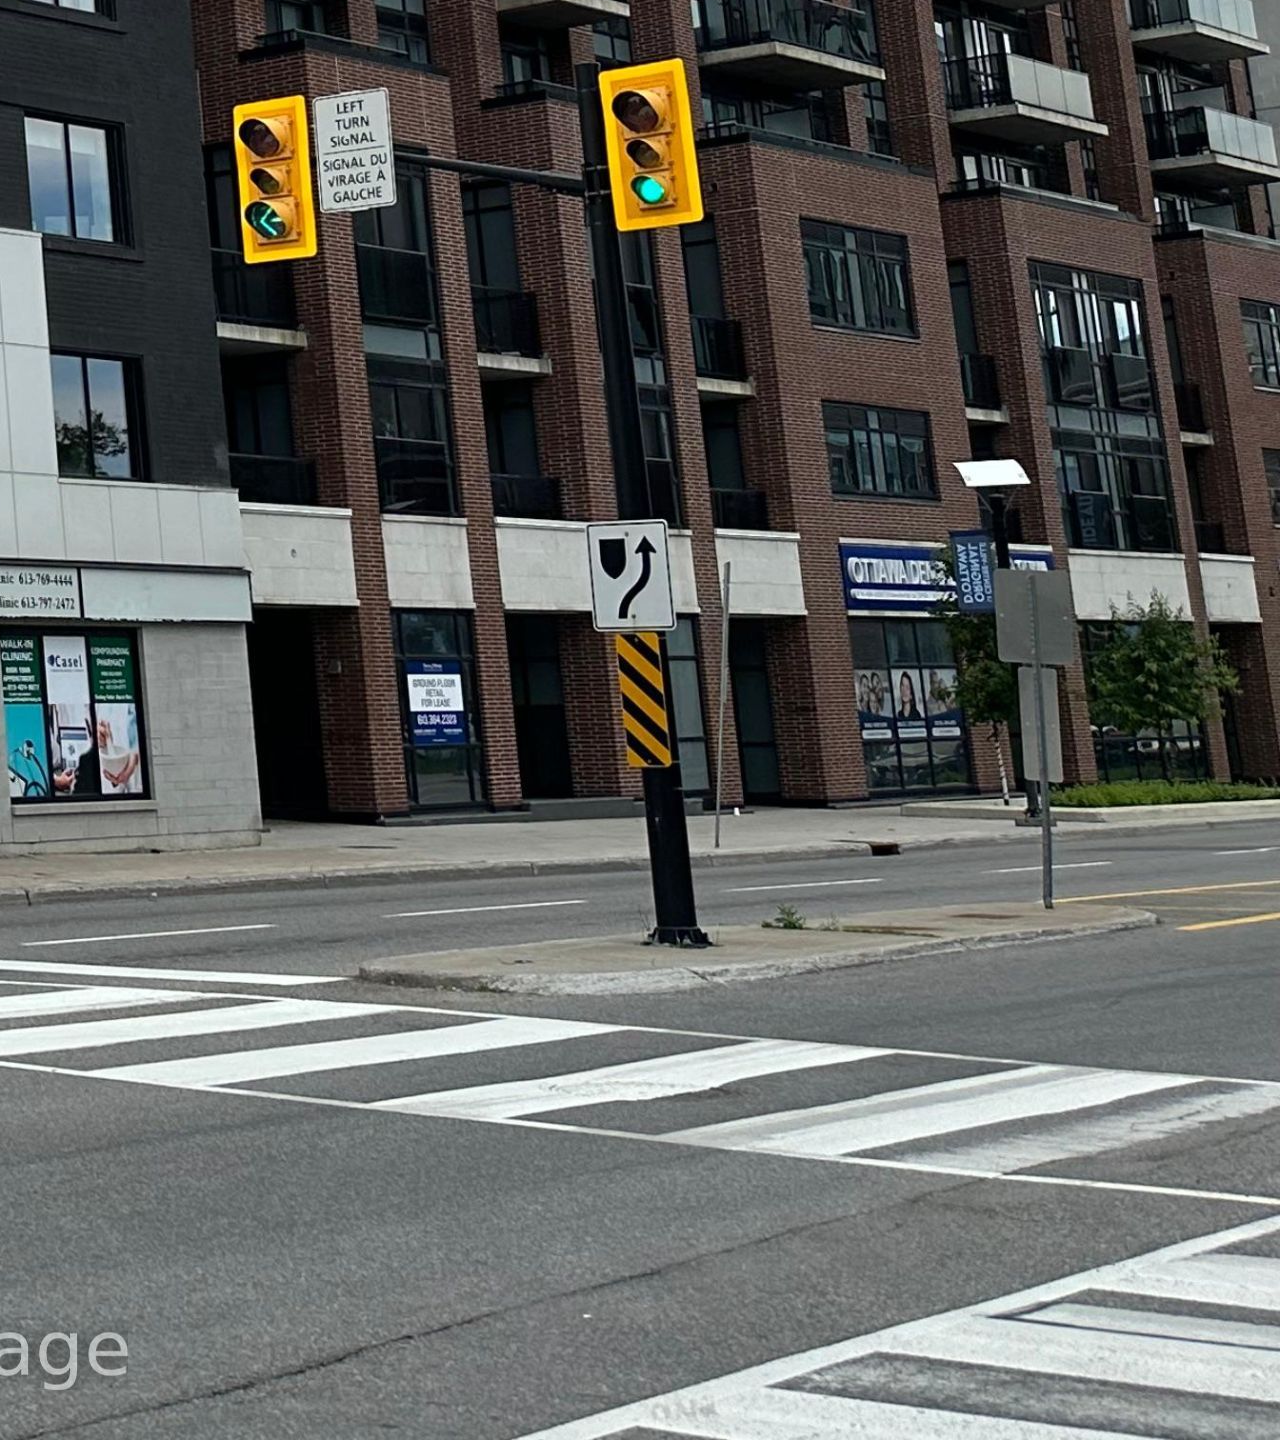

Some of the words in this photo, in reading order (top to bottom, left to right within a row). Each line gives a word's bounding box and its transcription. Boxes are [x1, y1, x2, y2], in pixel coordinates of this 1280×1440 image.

[336, 100, 364, 114] LEFT
[335, 115, 369, 131] TURN
[330, 131, 376, 148] SIGNAL
[323, 155, 366, 172] SIGNAL
[370, 152, 387, 166] DU
[328, 171, 371, 188] VIRAGE
[333, 186, 382, 203] GAUCHE
[848, 558, 907, 584] OTTAWA
[18, 572, 73, 586] 613-769-4444
[21, 596, 75, 610] 613-797-2472
[56, 654, 83, 667] Casel
[425, 688, 445, 697] RETAIL
[421, 698, 432, 707] FOR
[433, 698, 451, 707] LEASE
